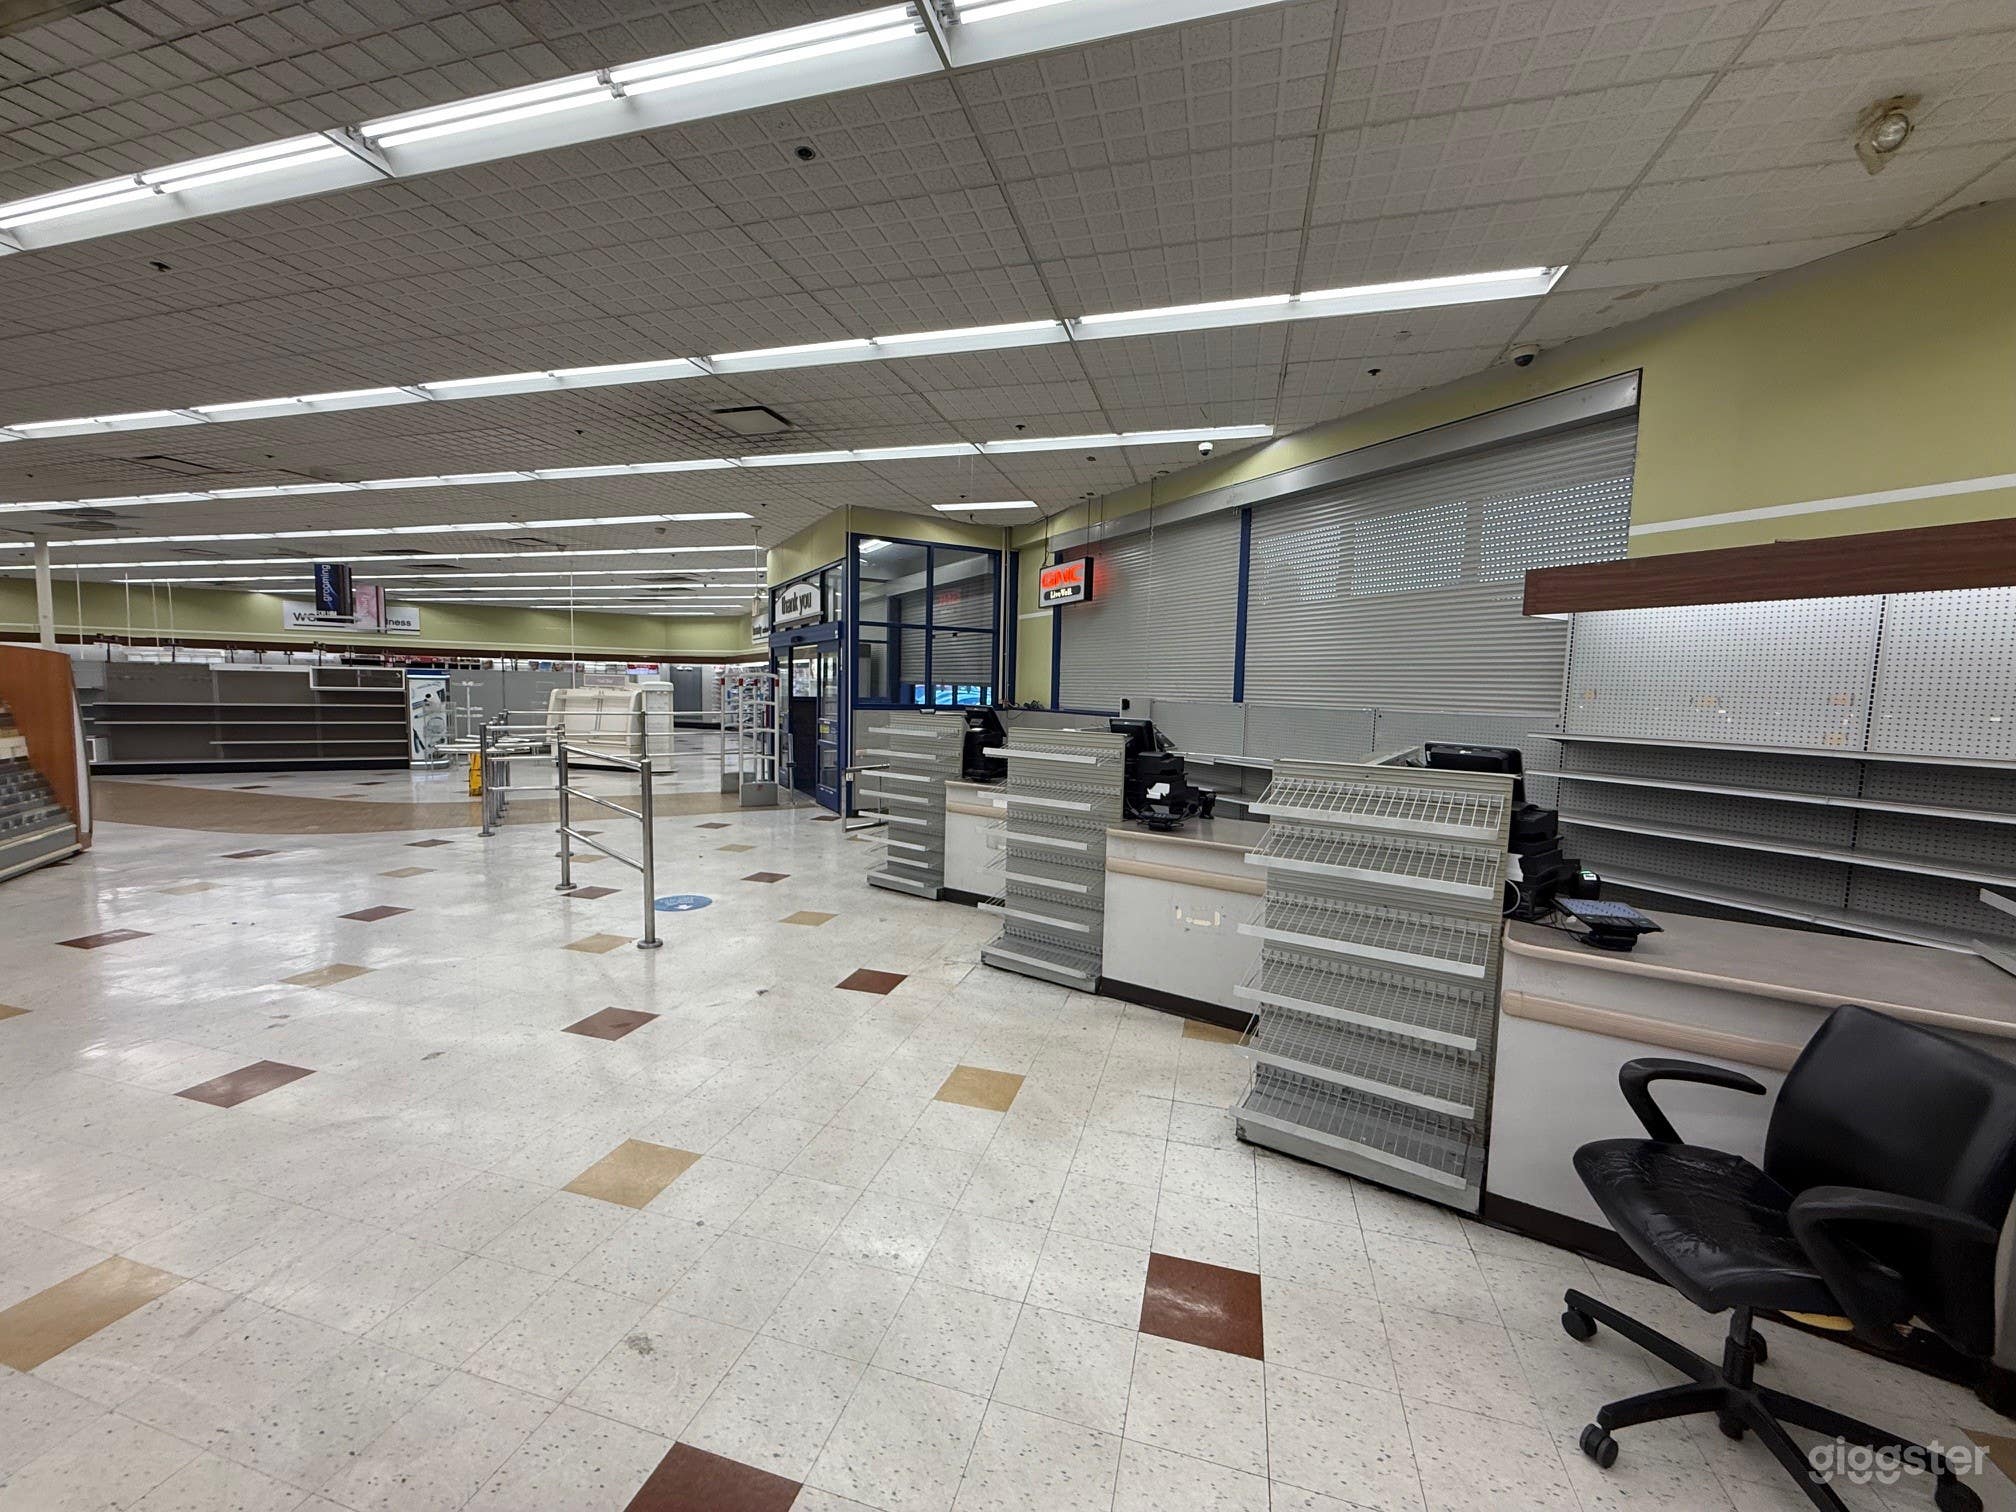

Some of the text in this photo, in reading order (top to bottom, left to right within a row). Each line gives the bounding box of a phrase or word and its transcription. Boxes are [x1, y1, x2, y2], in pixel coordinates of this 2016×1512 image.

[321, 564, 332, 602] grooming
[1041, 564, 1083, 588] GNC
[781, 592, 812, 616] thank you
